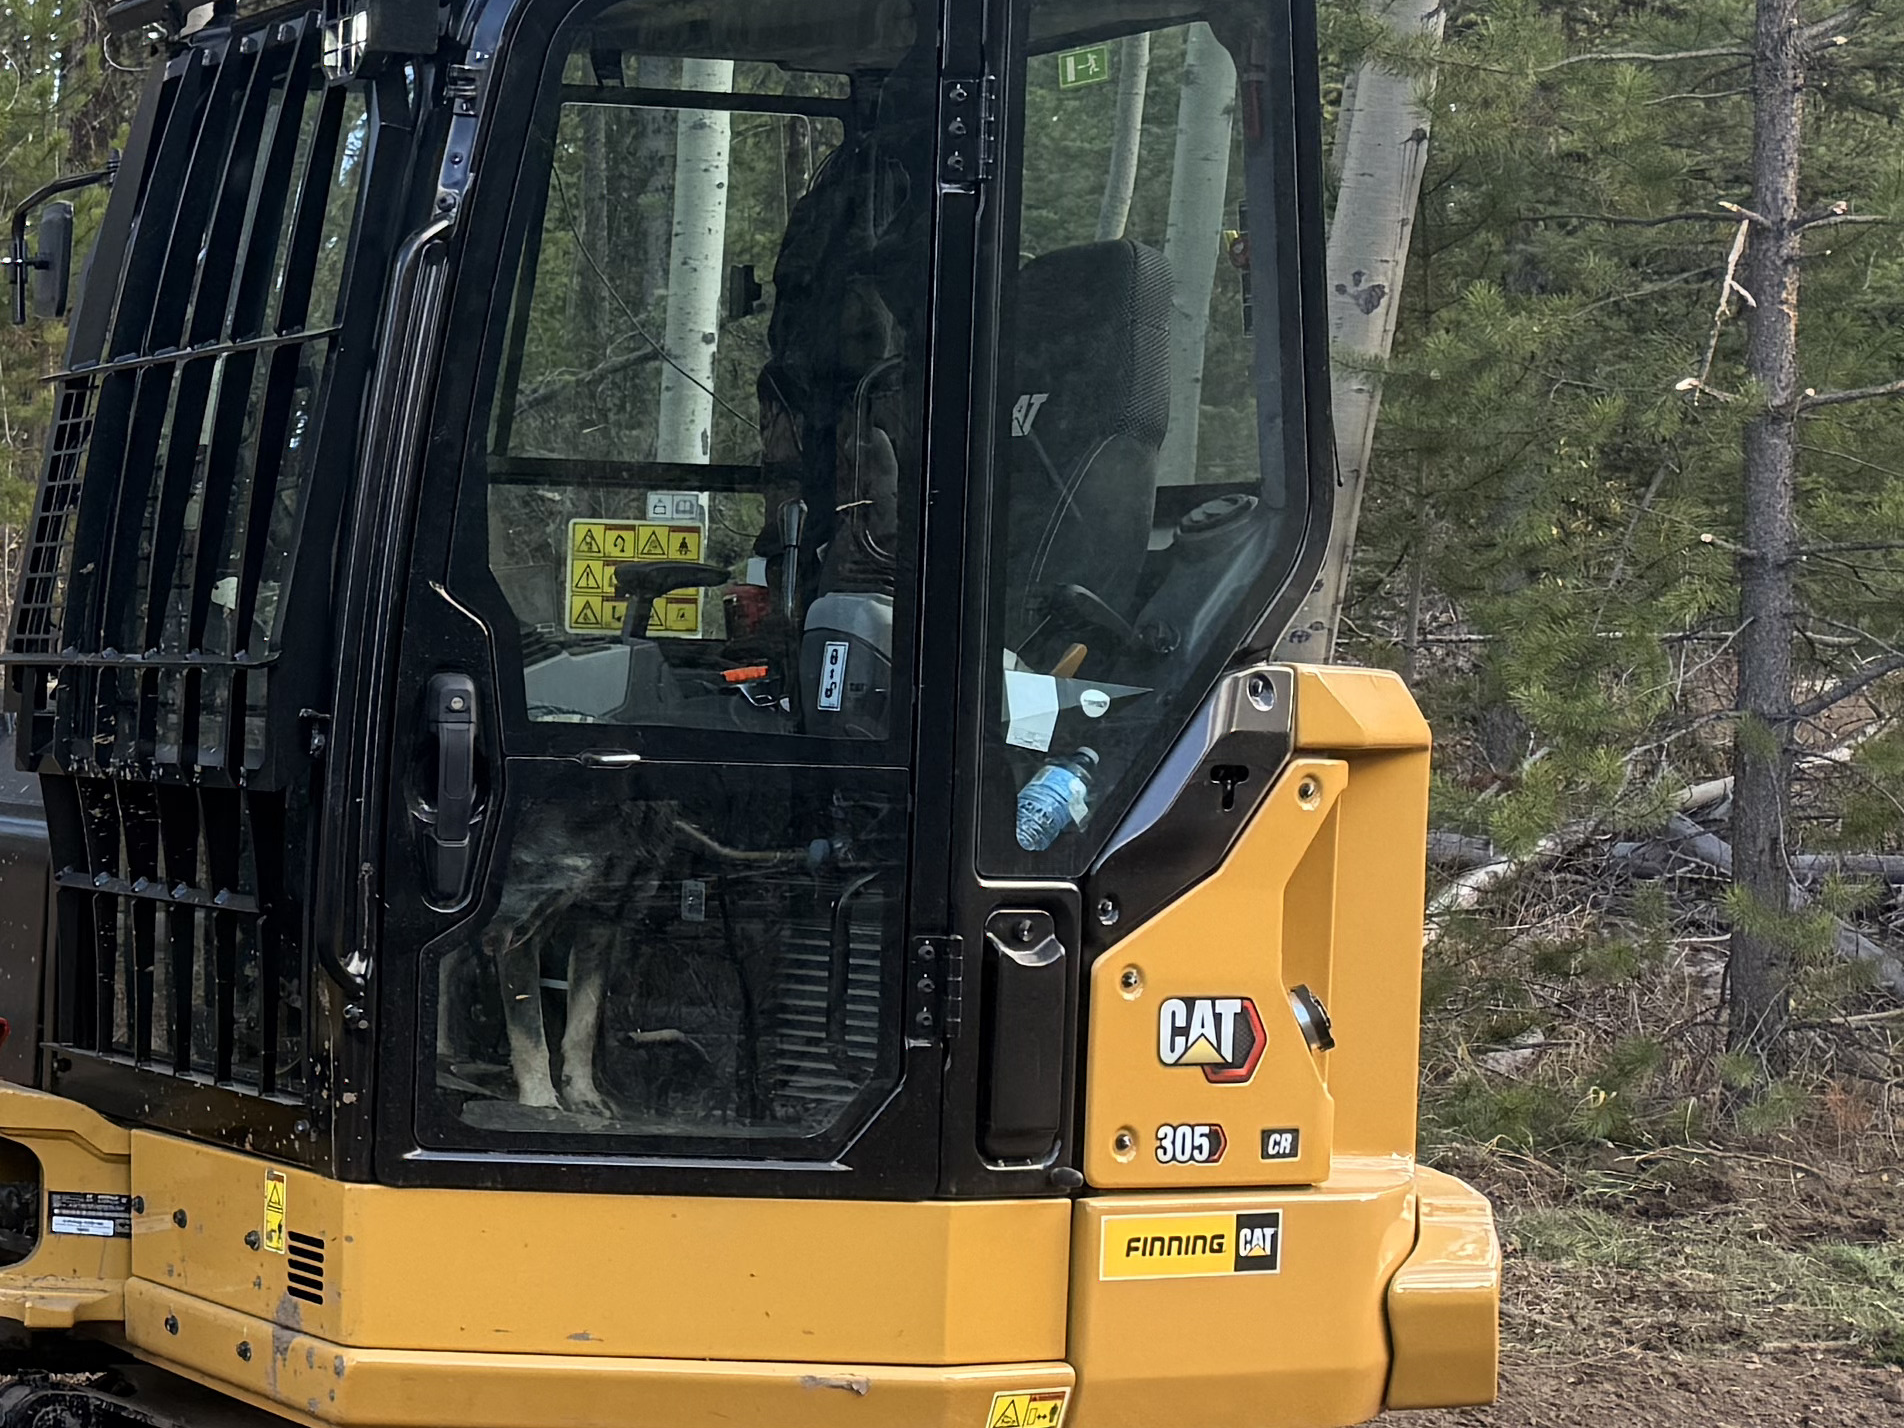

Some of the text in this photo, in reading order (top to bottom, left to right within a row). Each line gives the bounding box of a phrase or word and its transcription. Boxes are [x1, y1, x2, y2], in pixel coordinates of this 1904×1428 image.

[1011, 392, 1050, 437] AT
[1159, 998, 1242, 1065] CAT
[1156, 1124, 1293, 1163] 305 CR
[1125, 1227, 1277, 1258] FINNING CAT
